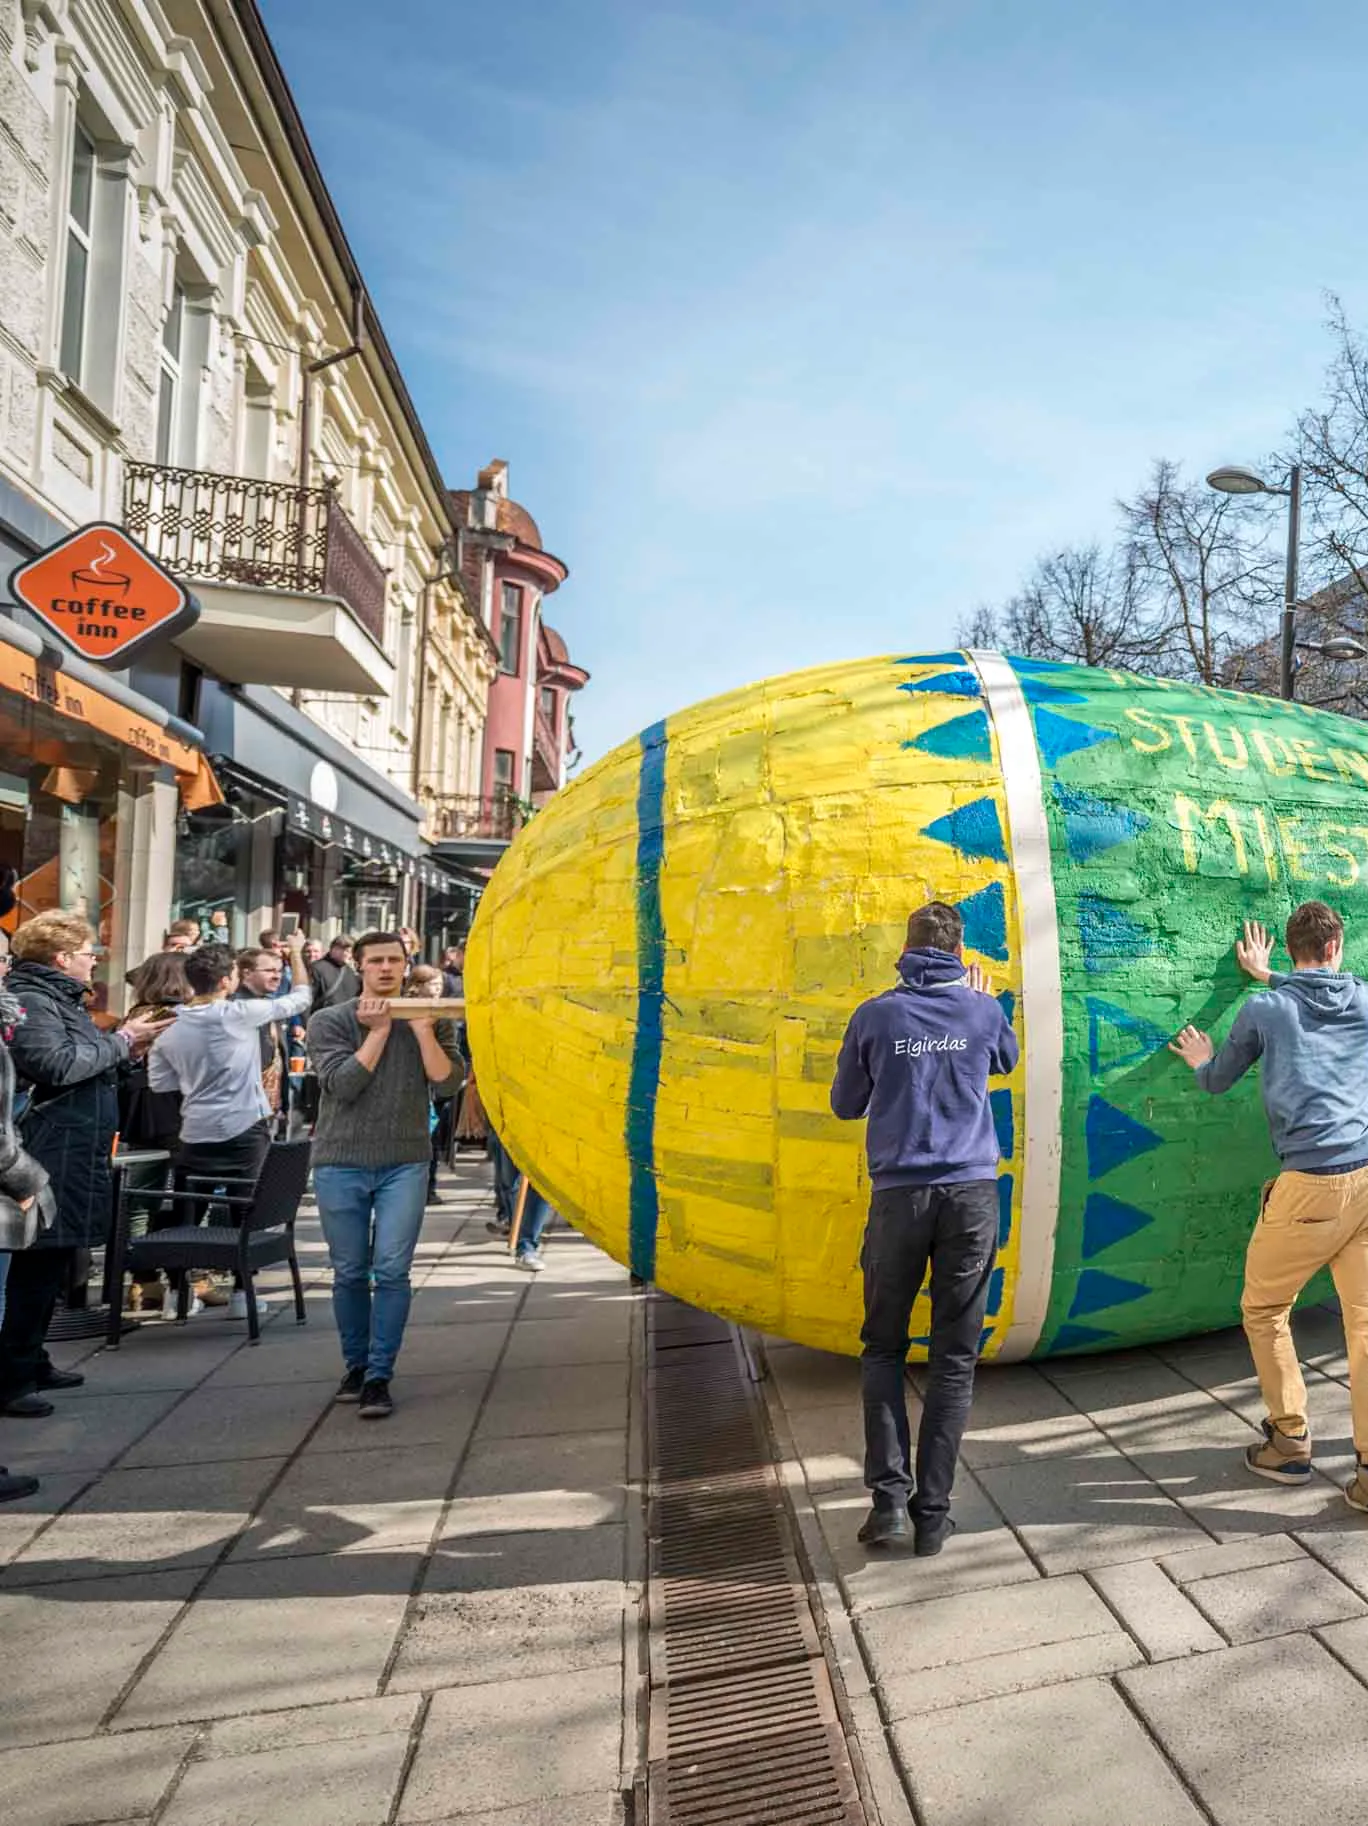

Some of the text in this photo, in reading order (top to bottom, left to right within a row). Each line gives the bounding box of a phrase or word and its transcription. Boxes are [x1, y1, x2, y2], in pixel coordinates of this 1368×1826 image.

[51, 598, 147, 621] coffee
[77, 618, 118, 638] inn
[895, 1032, 968, 1057] Eigirdas
